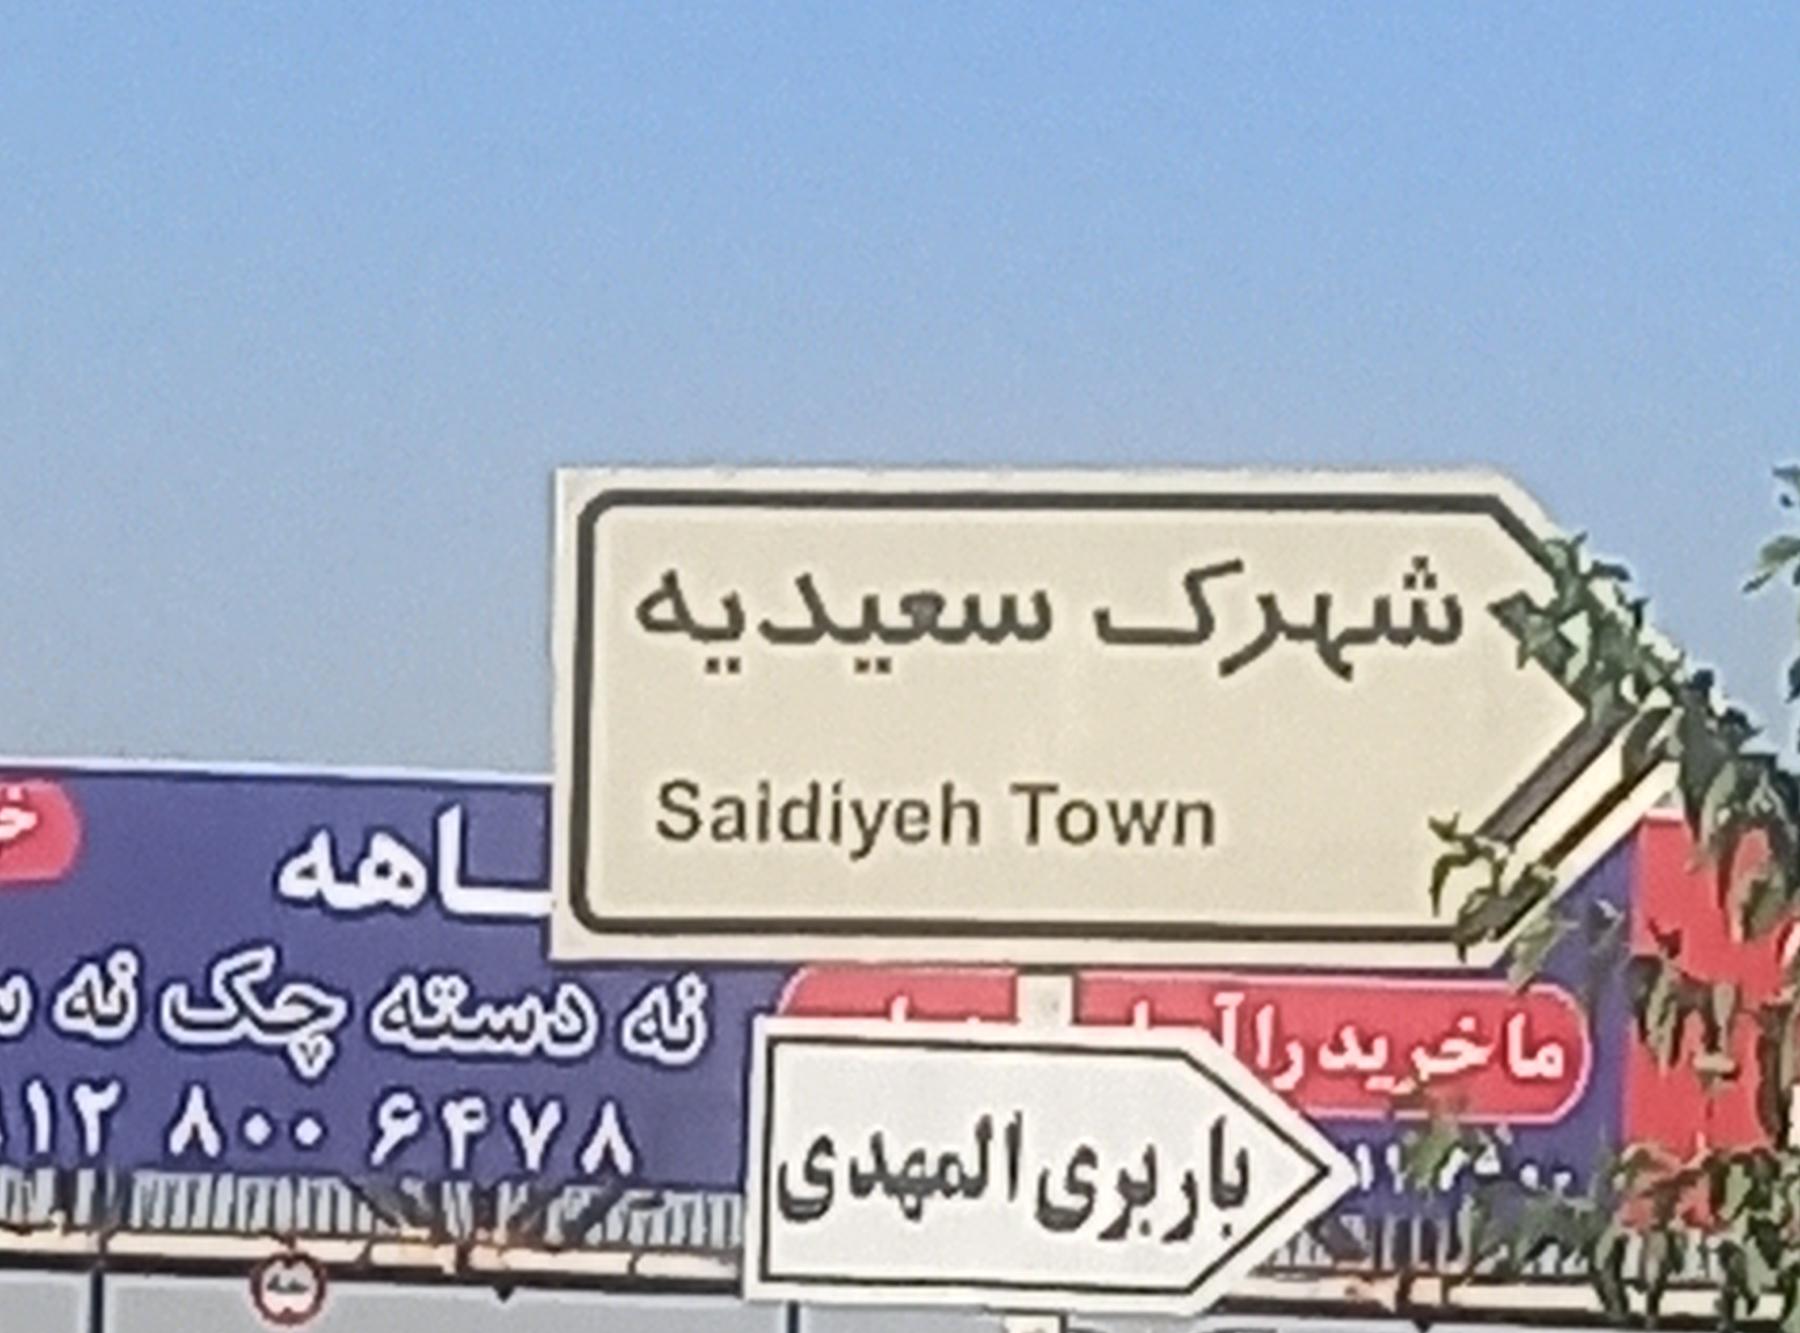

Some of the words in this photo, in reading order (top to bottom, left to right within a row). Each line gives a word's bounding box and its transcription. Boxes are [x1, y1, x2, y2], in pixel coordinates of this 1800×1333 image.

[636, 570, 1052, 673] سعیدیه
[1094, 555, 1463, 682] شهرک
[278, 805, 550, 917] اهه
[656, 778, 980, 861] Saidiyeh
[1011, 783, 1214, 846] Town
[54, 950, 138, 1040] نه
[161, 946, 346, 1077] چک
[371, 974, 598, 1056] دسته
[622, 972, 708, 1064] نه
[1317, 1015, 1498, 1095] خرید
[1507, 1012, 1564, 1080] ما
[169, 1084, 323, 1159] ۸۰۰
[371, 1092, 635, 1175] ۶۴۷۸
[777, 1109, 1022, 1223] المهدی
[1035, 1114, 1248, 1243] باربری
